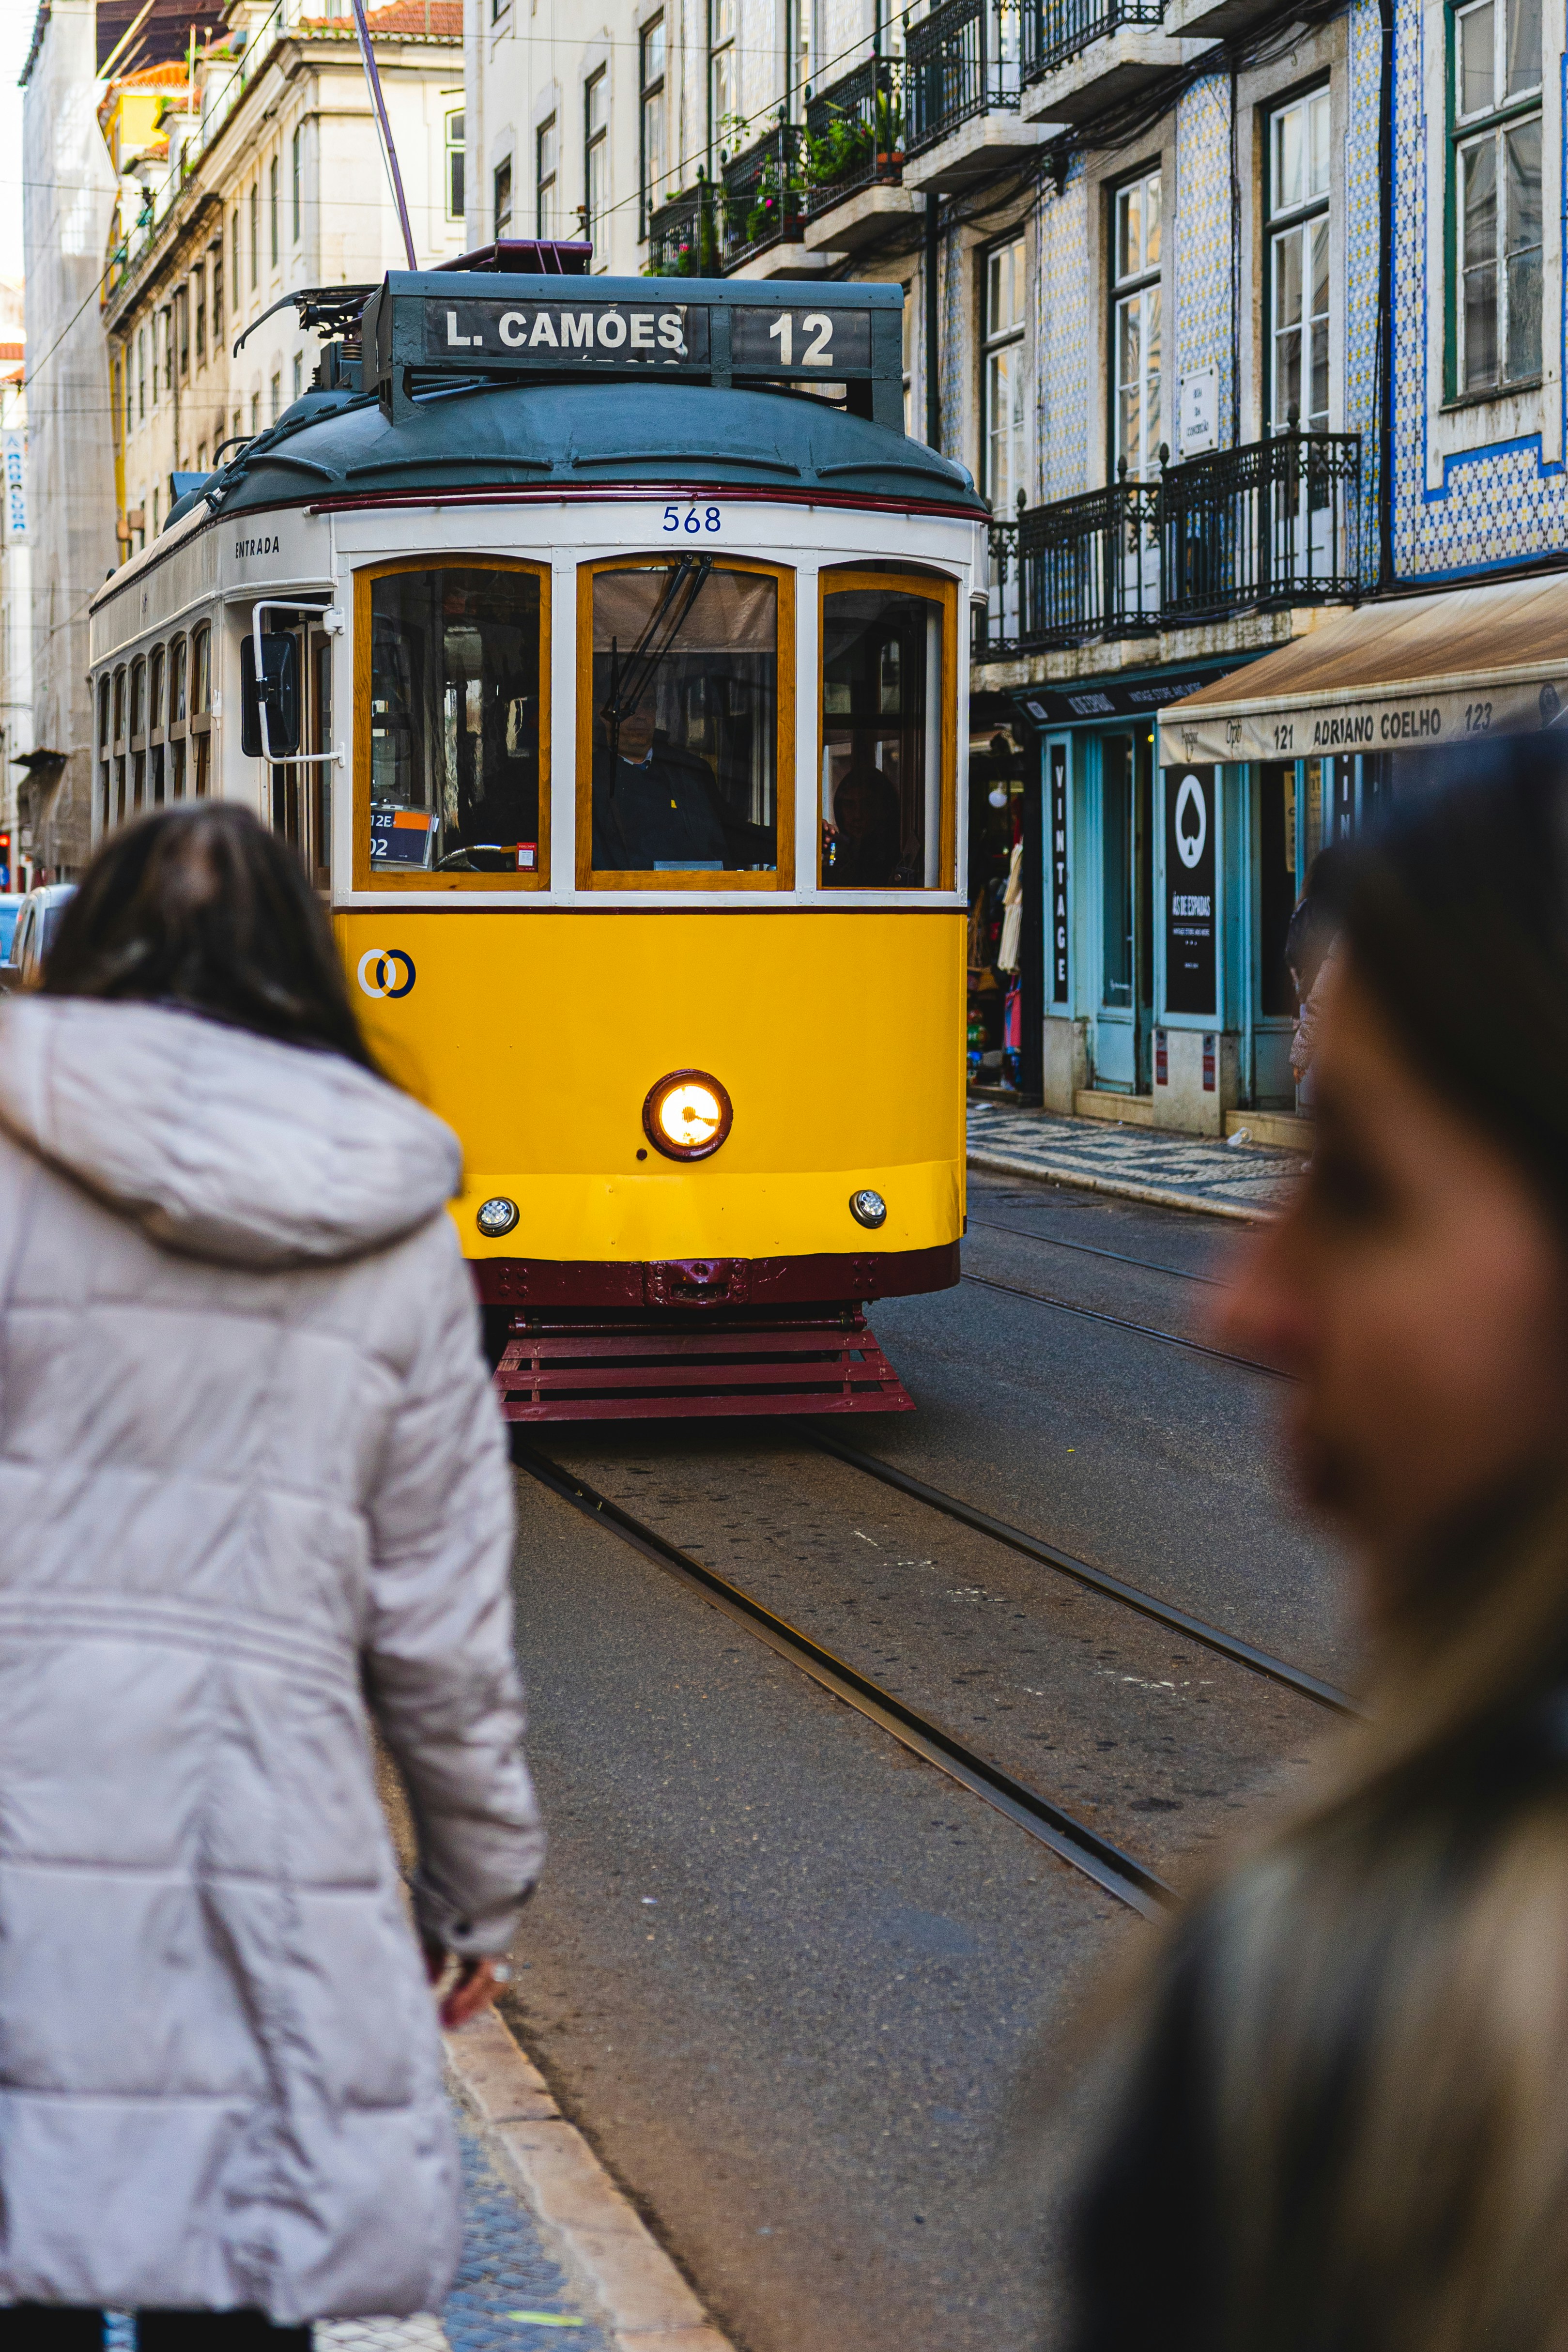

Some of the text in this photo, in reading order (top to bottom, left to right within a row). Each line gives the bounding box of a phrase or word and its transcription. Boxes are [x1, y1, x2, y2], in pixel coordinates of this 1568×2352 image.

[447, 309, 684, 348] L. CAMÕES
[770, 313, 833, 366] 12
[662, 507, 721, 533] 568
[235, 536, 279, 559] ENTRADA
[1314, 708, 1441, 746] ADRIANO COELHO
[1465, 702, 1492, 732] 123
[1274, 724, 1293, 750] 121
[370, 815, 392, 827] 12E
[1055, 766, 1065, 981] VINTAGE
